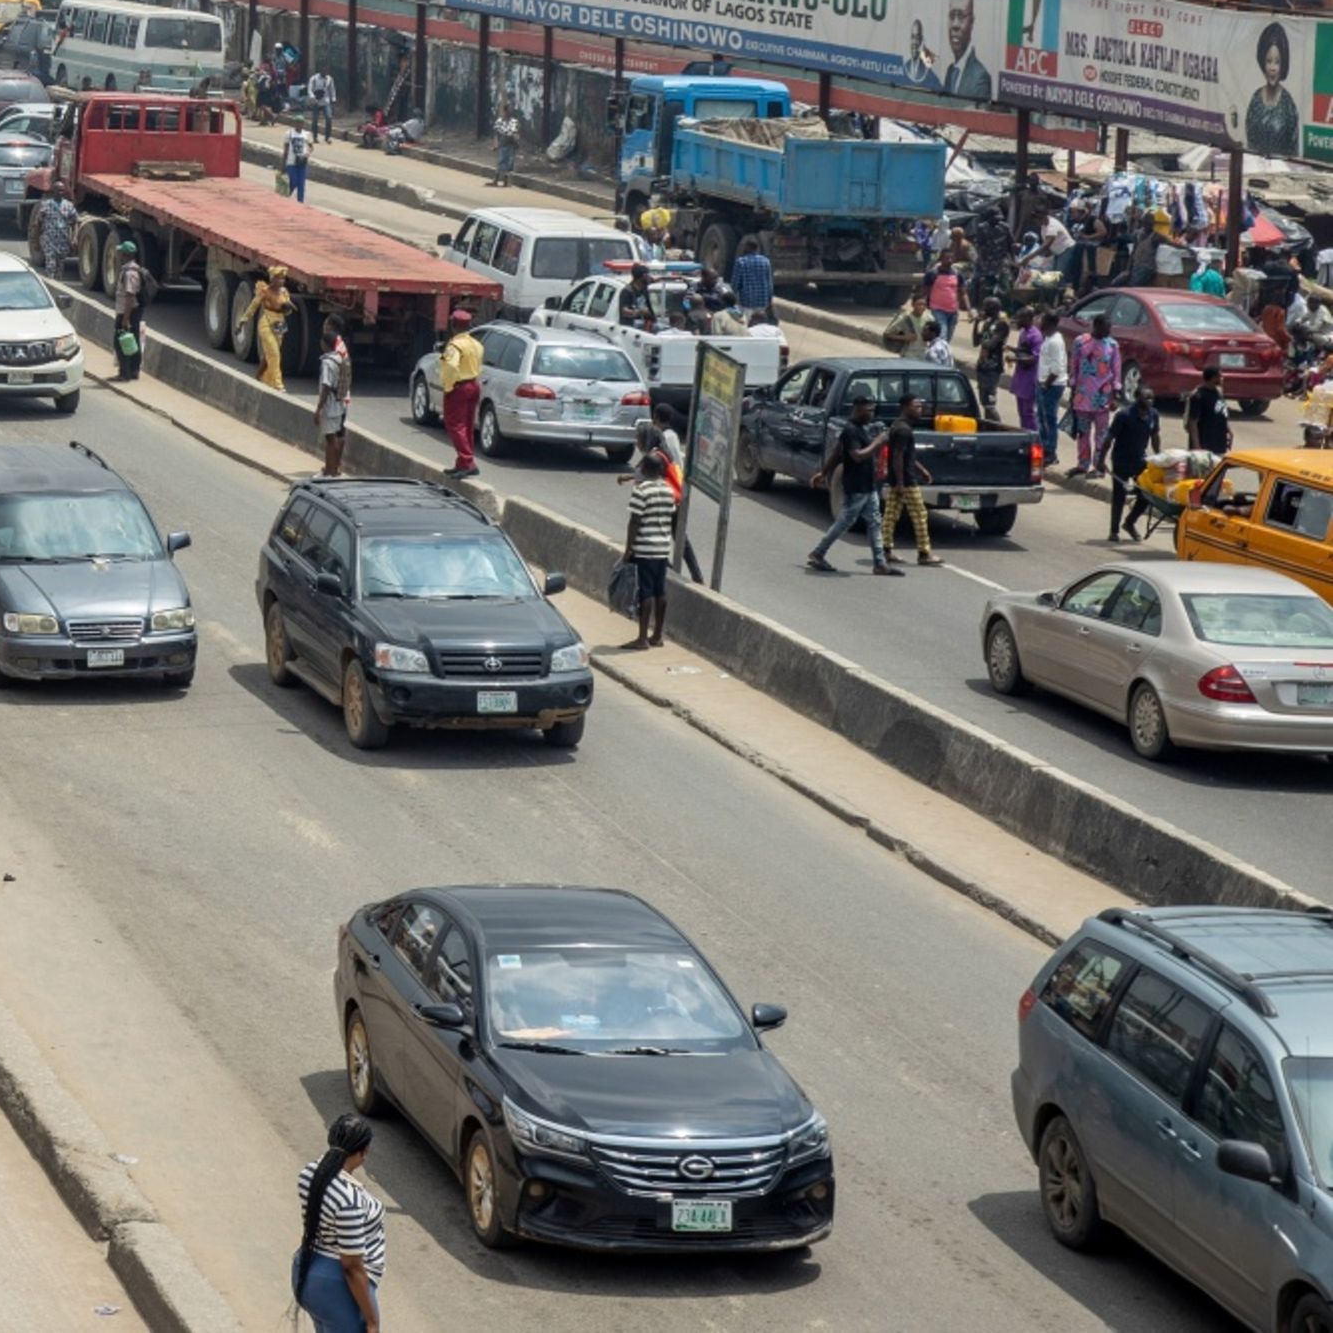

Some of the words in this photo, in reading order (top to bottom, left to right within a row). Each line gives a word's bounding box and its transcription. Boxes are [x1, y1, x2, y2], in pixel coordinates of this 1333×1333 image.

[579, 8, 625, 30] DELE
[631, 15, 743, 50] OSHINOWO
[716, 1, 765, 23] LAGOS
[769, 9, 814, 30] STATE
[1130, 21, 1163, 37] ELECT
[1015, 48, 1048, 75] APC
[1065, 32, 1089, 58] MRS.
[1093, 35, 1136, 66] ADETOLA
[1124, 73, 1153, 92] FEDERAL
[1045, 85, 1074, 104] MAYOR
[1075, 91, 1095, 109] DELE
[1096, 96, 1142, 118] OSHINOWO
